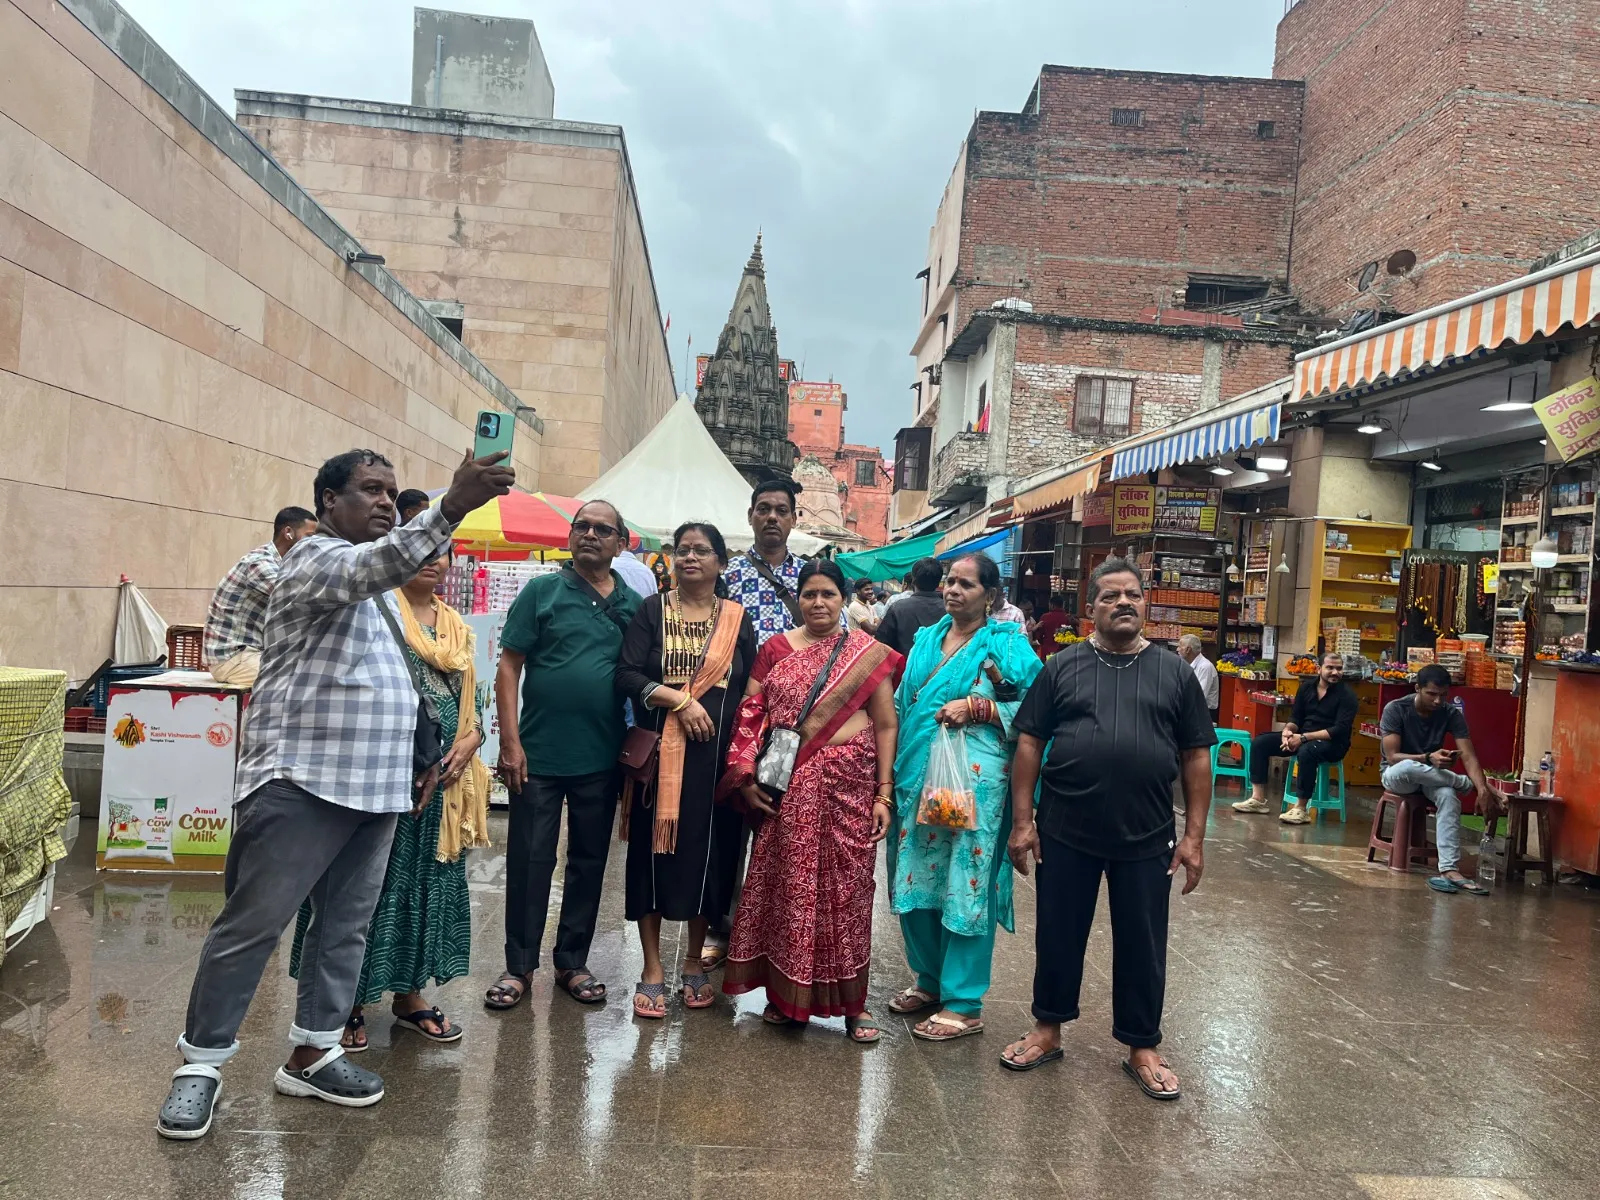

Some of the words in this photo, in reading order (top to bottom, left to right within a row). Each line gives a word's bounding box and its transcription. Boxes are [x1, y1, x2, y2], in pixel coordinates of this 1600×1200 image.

[1545, 385, 1596, 417] लॉकर
[1119, 488, 1150, 500] लॉकर
[1117, 503, 1150, 520] सुविधा
[193, 806, 217, 815] Amul
[146, 818, 172, 827] Cow
[178, 813, 228, 830] Cow
[187, 830, 217, 843] Milk
